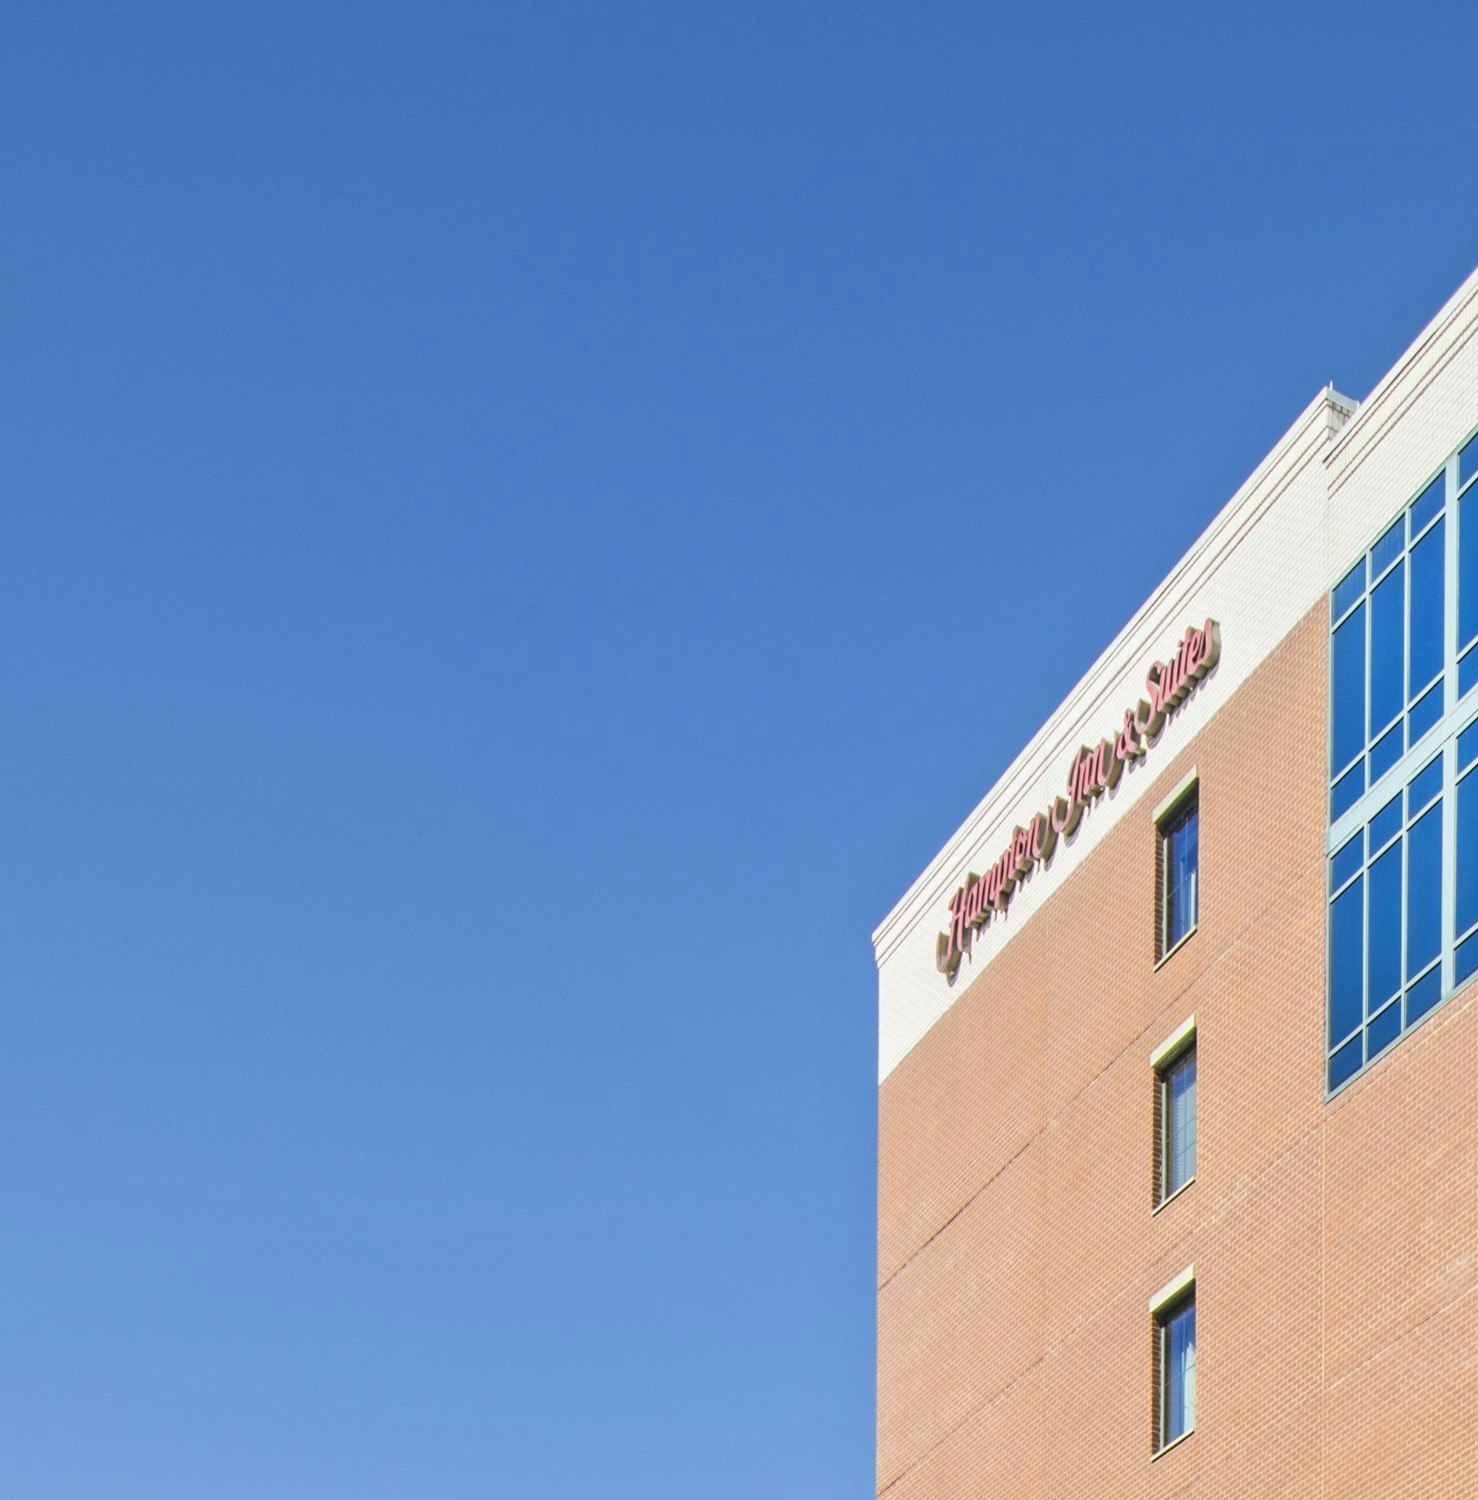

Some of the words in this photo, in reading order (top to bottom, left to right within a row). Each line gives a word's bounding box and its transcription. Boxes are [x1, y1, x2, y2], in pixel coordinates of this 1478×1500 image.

[936, 804, 1055, 975] Hampton
[1052, 730, 1121, 835] Inn
[1117, 708, 1142, 759] &
[1134, 617, 1220, 735] Suites
